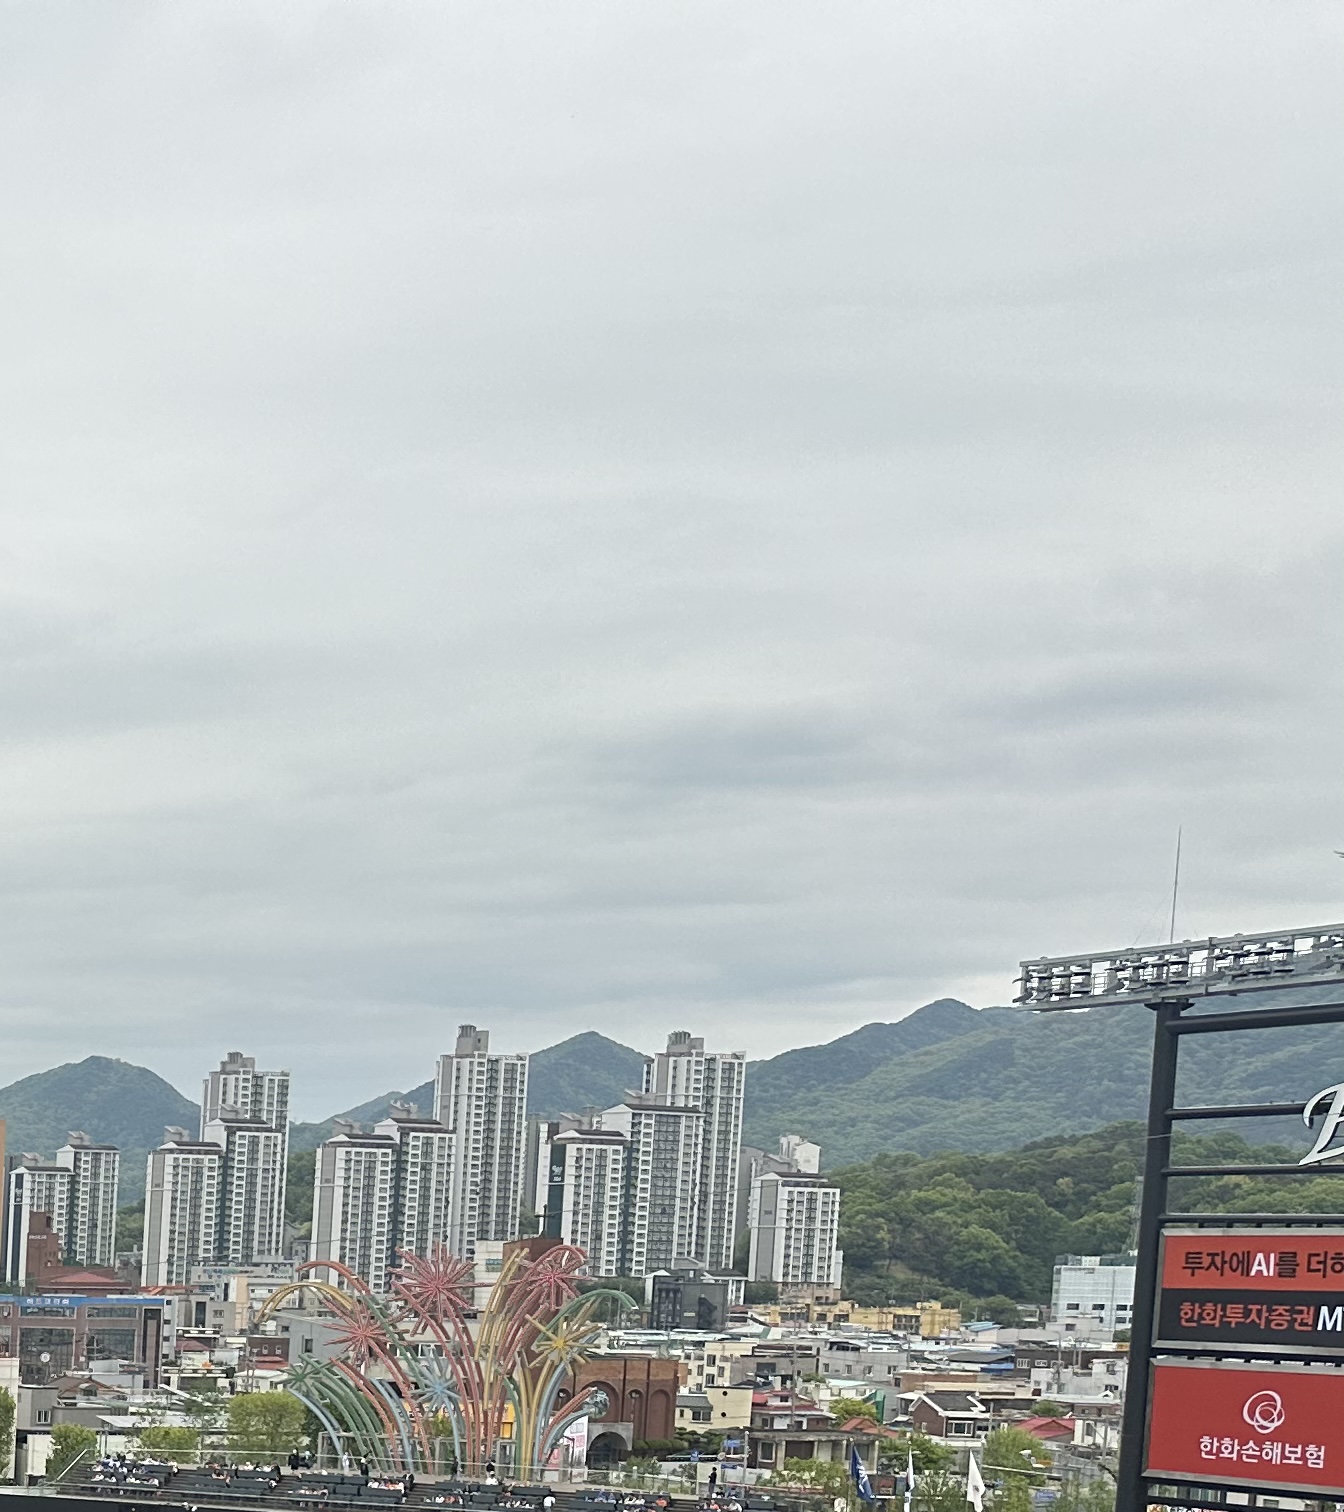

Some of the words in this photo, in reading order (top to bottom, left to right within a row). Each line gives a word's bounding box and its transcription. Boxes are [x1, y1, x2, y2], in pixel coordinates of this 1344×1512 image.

[1182, 1251, 1300, 1278] 투자에AI를
[1179, 1302, 1316, 1331] 한화투자증권
[1199, 1435, 1326, 1469] 한화손해보험
